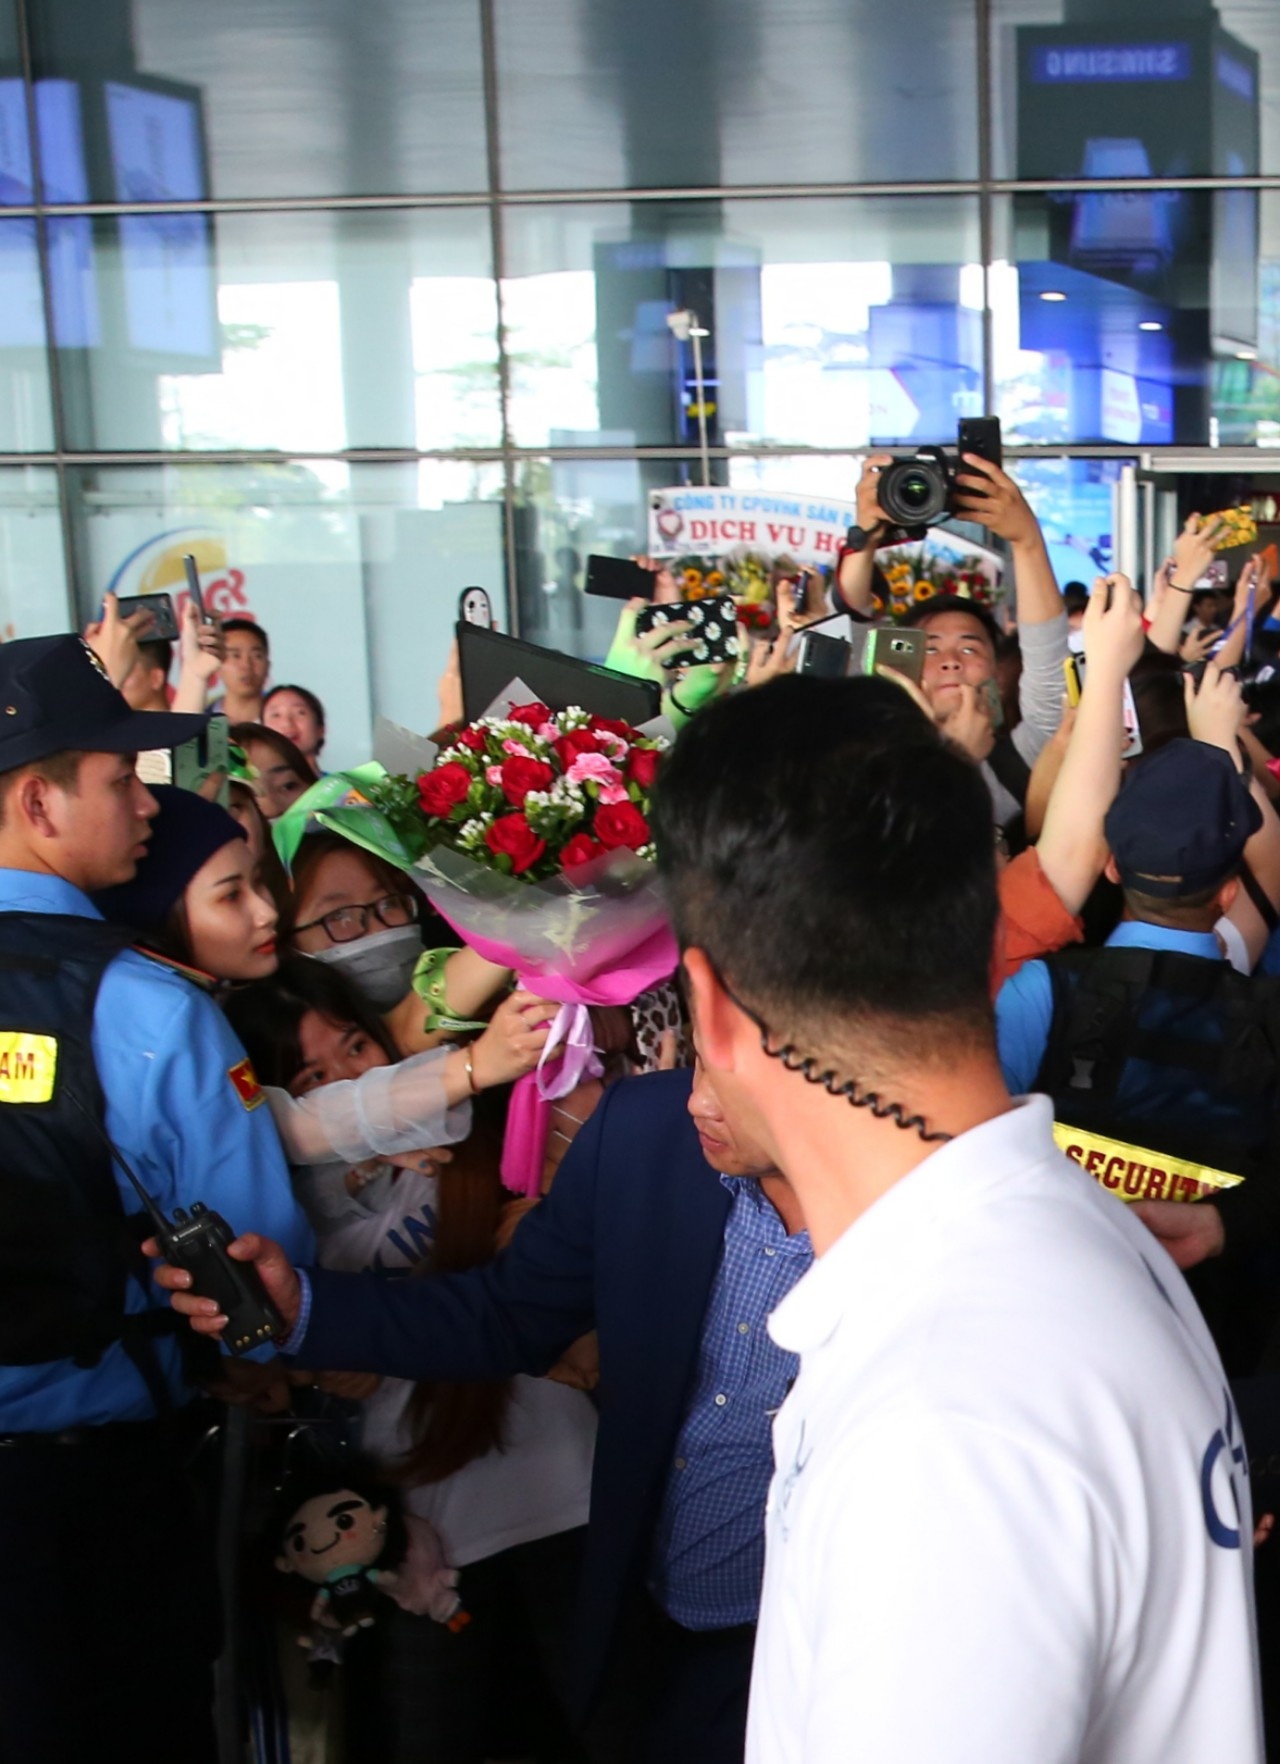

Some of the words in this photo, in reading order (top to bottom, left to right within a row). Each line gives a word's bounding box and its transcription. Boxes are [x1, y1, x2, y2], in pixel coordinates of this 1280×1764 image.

[673, 493, 714, 511] CÔNG
[719, 495, 736, 510] TY
[690, 520, 757, 545] DỊCH
[766, 523, 806, 551] VỤ
[0, 1052, 35, 1080] AM
